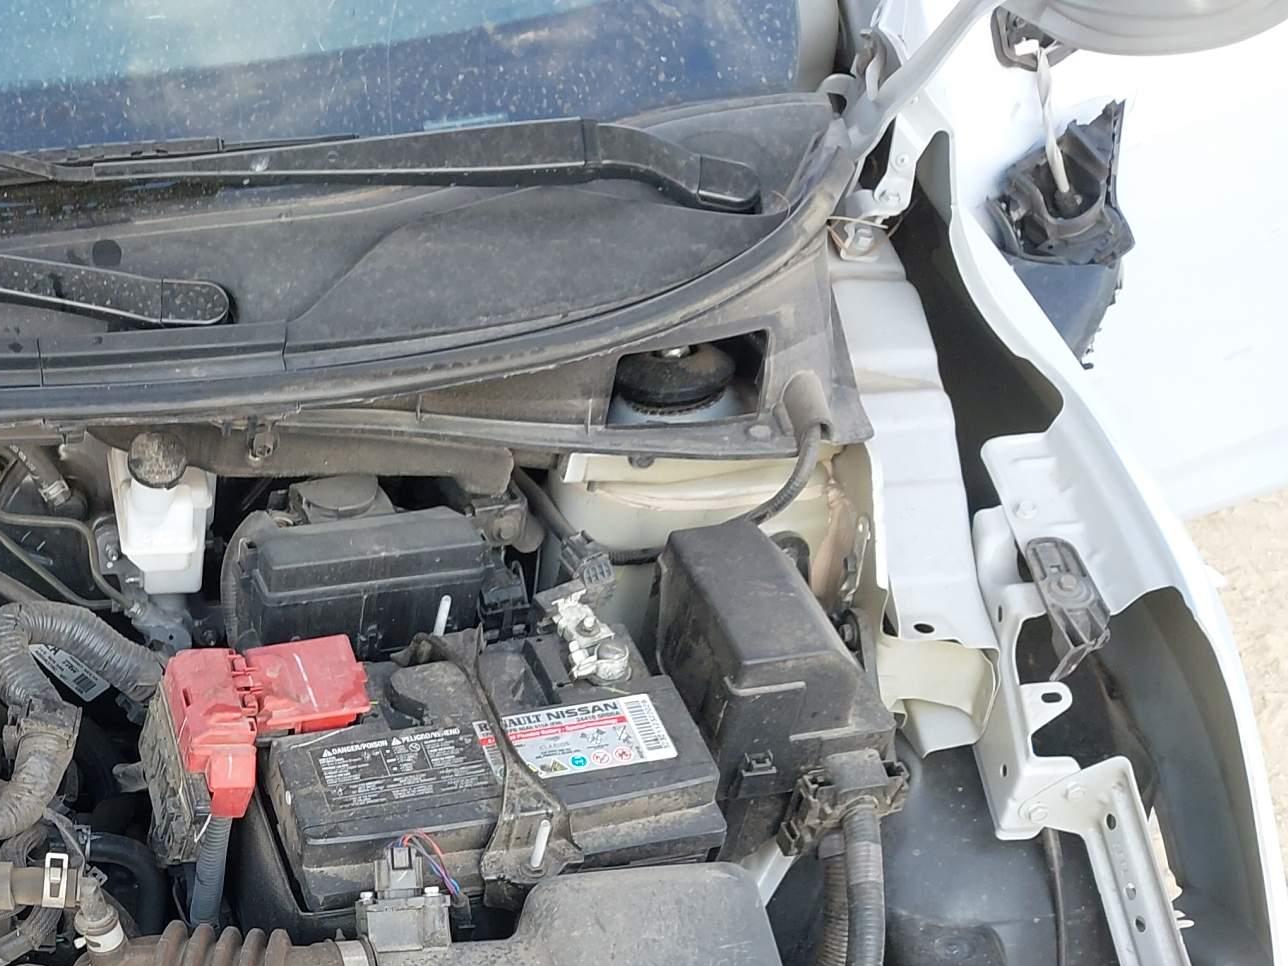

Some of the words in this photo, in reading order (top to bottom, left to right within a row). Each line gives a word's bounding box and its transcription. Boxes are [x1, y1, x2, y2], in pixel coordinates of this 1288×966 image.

[478, 714, 543, 733] RAULT
[547, 702, 618, 721] NISSAN
[332, 740, 388, 755] DANGER/POISON
